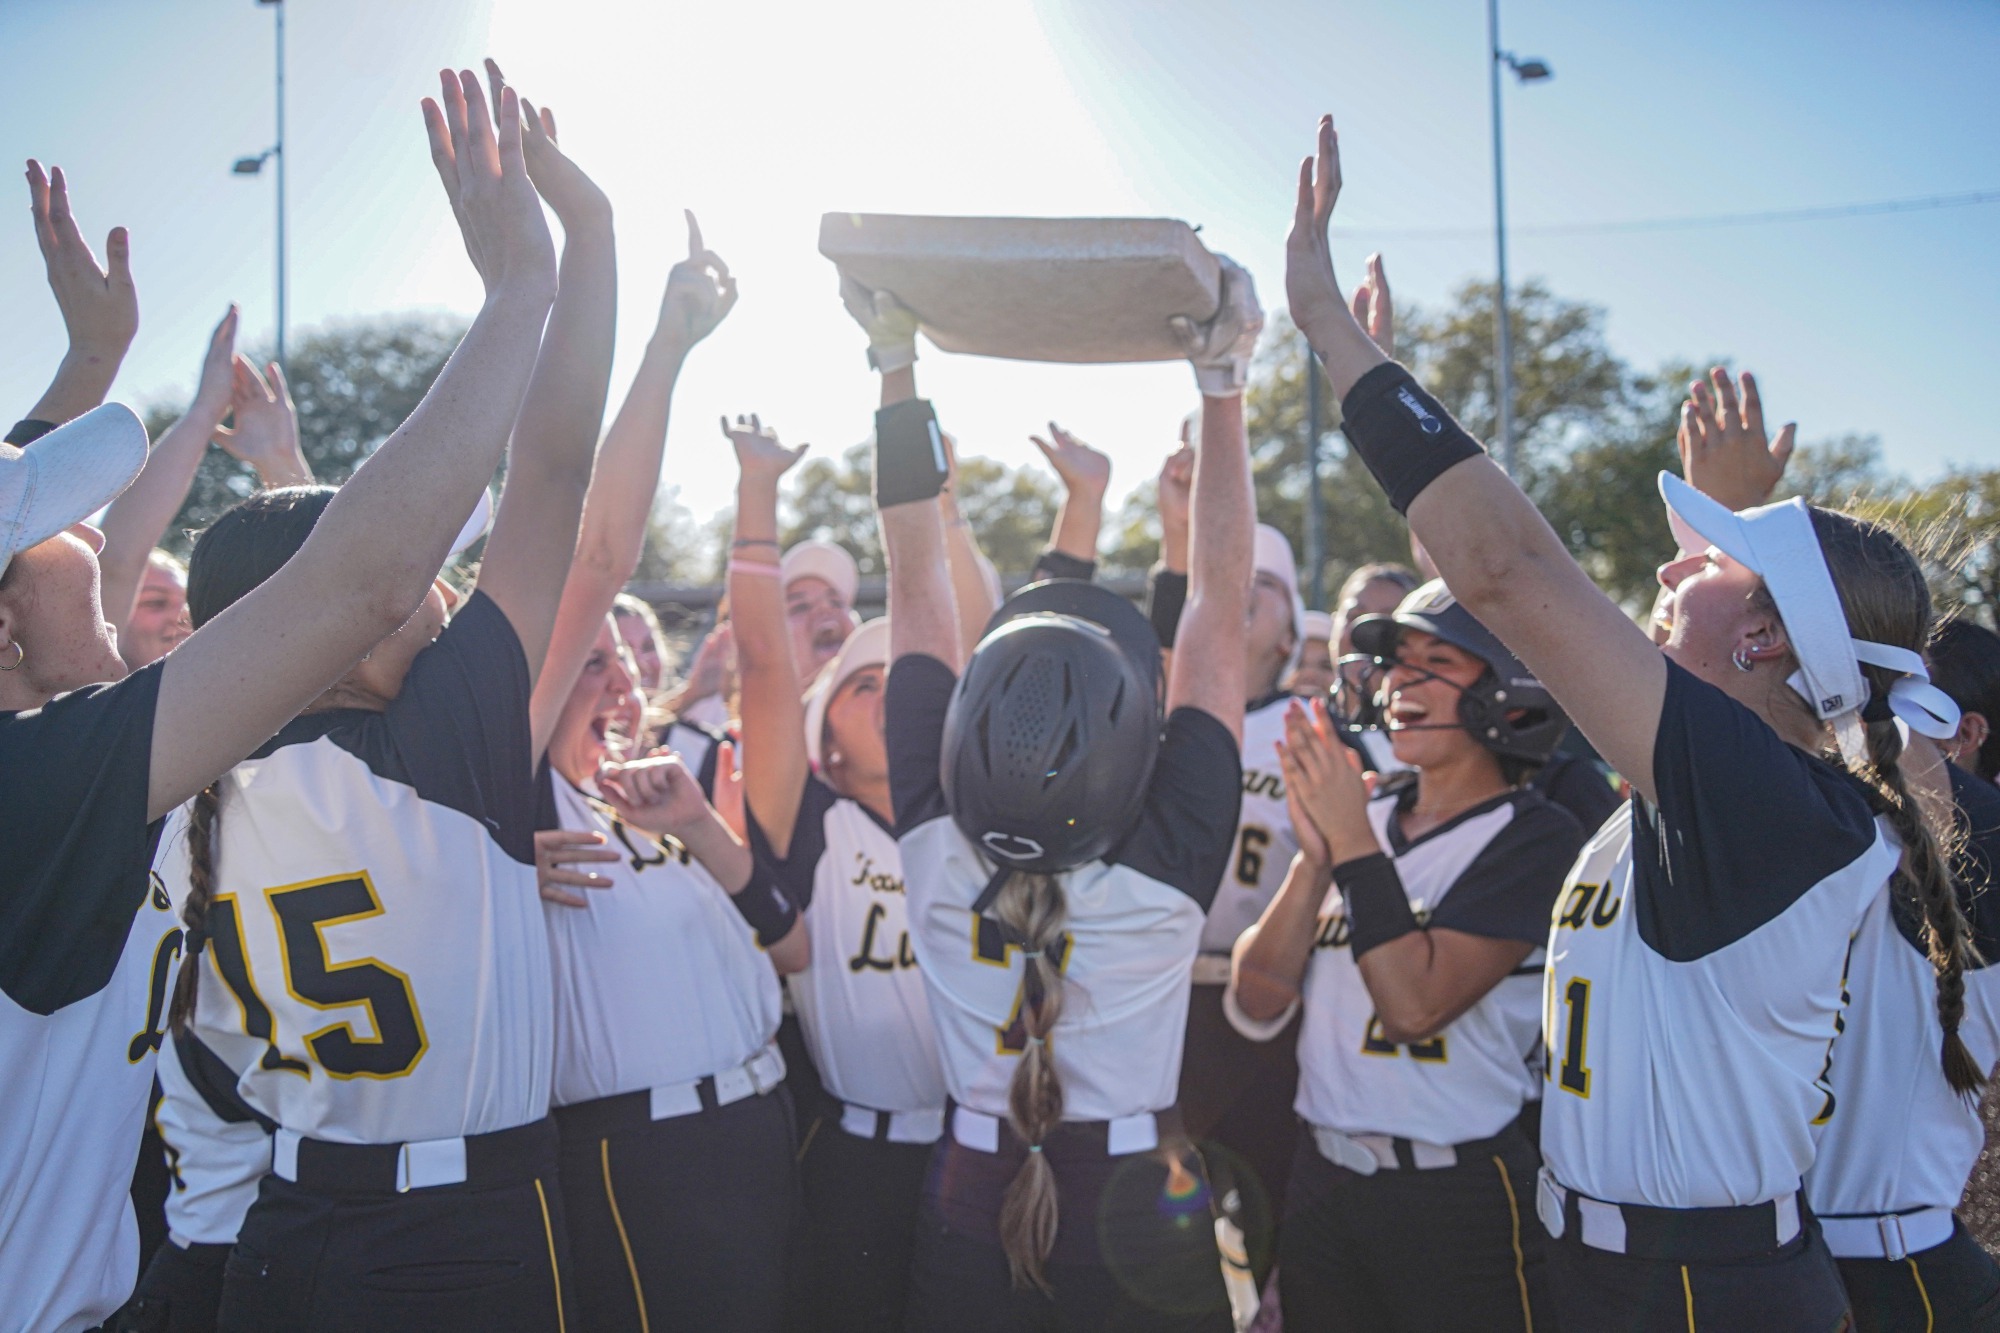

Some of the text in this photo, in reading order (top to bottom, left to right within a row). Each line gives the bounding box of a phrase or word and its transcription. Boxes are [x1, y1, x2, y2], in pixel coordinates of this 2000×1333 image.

[1236, 824, 1271, 887] 6
[205, 868, 430, 1083] 15
[971, 911, 1075, 1056] 7
